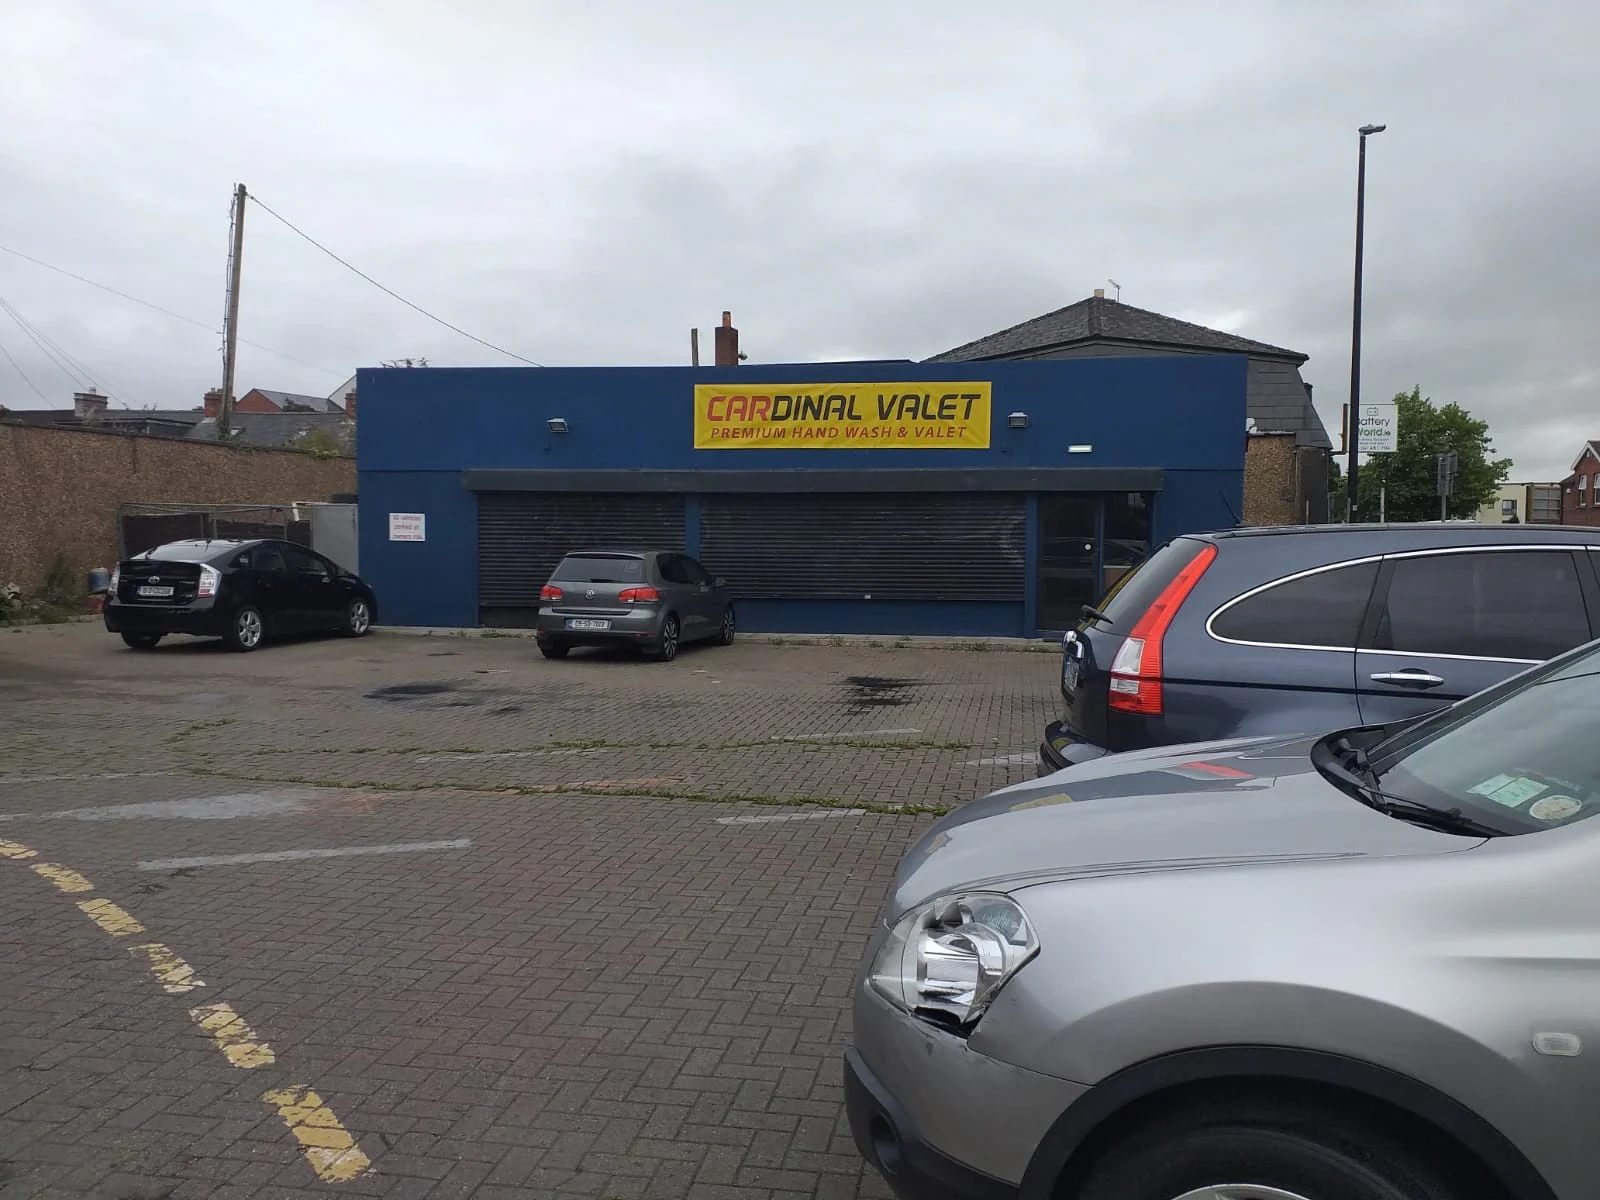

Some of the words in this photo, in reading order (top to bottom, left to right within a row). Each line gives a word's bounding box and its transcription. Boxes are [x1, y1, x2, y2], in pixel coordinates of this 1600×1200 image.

[707, 394, 862, 422] CARDINAL
[877, 393, 982, 421] VALET
[1358, 417, 1391, 427] attery
[711, 427, 787, 439] PREMIUM
[792, 426, 839, 439] HAND
[845, 426, 892, 439] WASH
[897, 426, 907, 438] &
[914, 426, 967, 438] VALET
